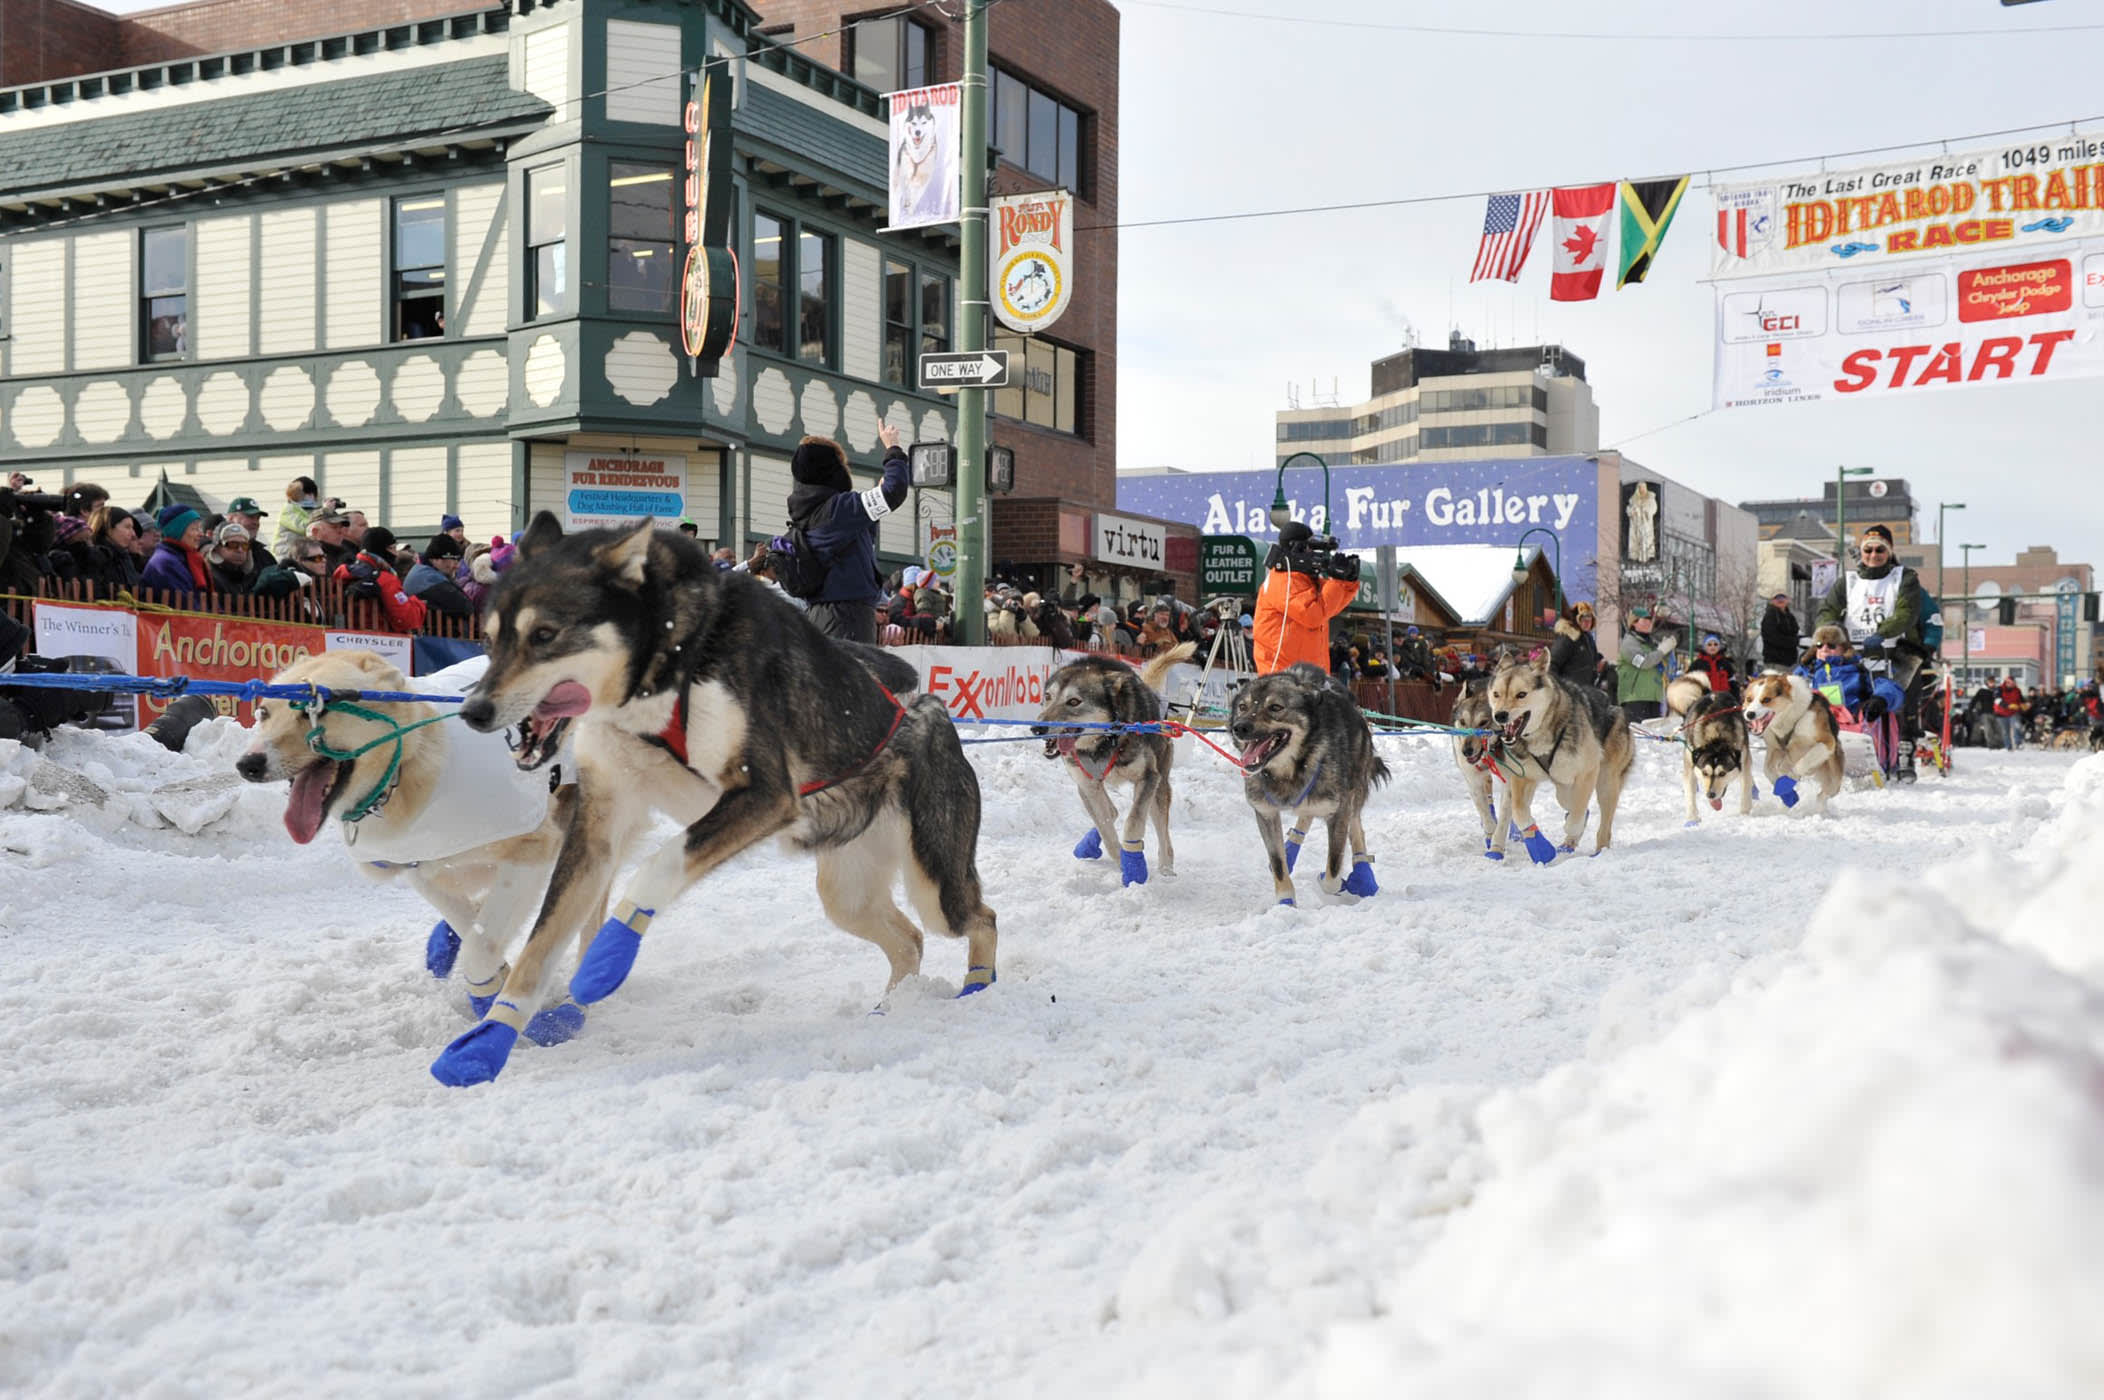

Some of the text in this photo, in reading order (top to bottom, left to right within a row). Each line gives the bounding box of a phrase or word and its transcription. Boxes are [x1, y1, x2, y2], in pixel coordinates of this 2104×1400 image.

[892, 84, 959, 116] IDITAROD
[2002, 145, 2050, 168] 1049
[1825, 176, 1864, 194] Last
[1872, 168, 1921, 188] Great
[1784, 181, 1975, 250] IDITAROD
[1887, 218, 2014, 253] RACE
[1972, 267, 2057, 287] Anchorage
[1968, 284, 2062, 304] Chrysler Dodge
[1998, 301, 2031, 314] Jeep
[1763, 315, 1800, 331] GCI
[931, 362, 983, 377] ONE WAY
[1834, 329, 2077, 393] START
[588, 458, 665, 473] ANCHORAGE
[572, 472, 680, 488] FUR RENDEZVOUS
[1202, 486, 1579, 535] Alaka Fur Gallery
[1104, 524, 1159, 562] virtu
[1212, 544, 1247, 555] FUR &
[1205, 557, 1253, 568] LEATHER
[1205, 570, 1253, 583] OUTLET
[1860, 606, 1886, 625] 46
[41, 616, 63, 631] The
[65, 620, 120, 635] Winner's
[336, 635, 405, 648] CHRYSLER
